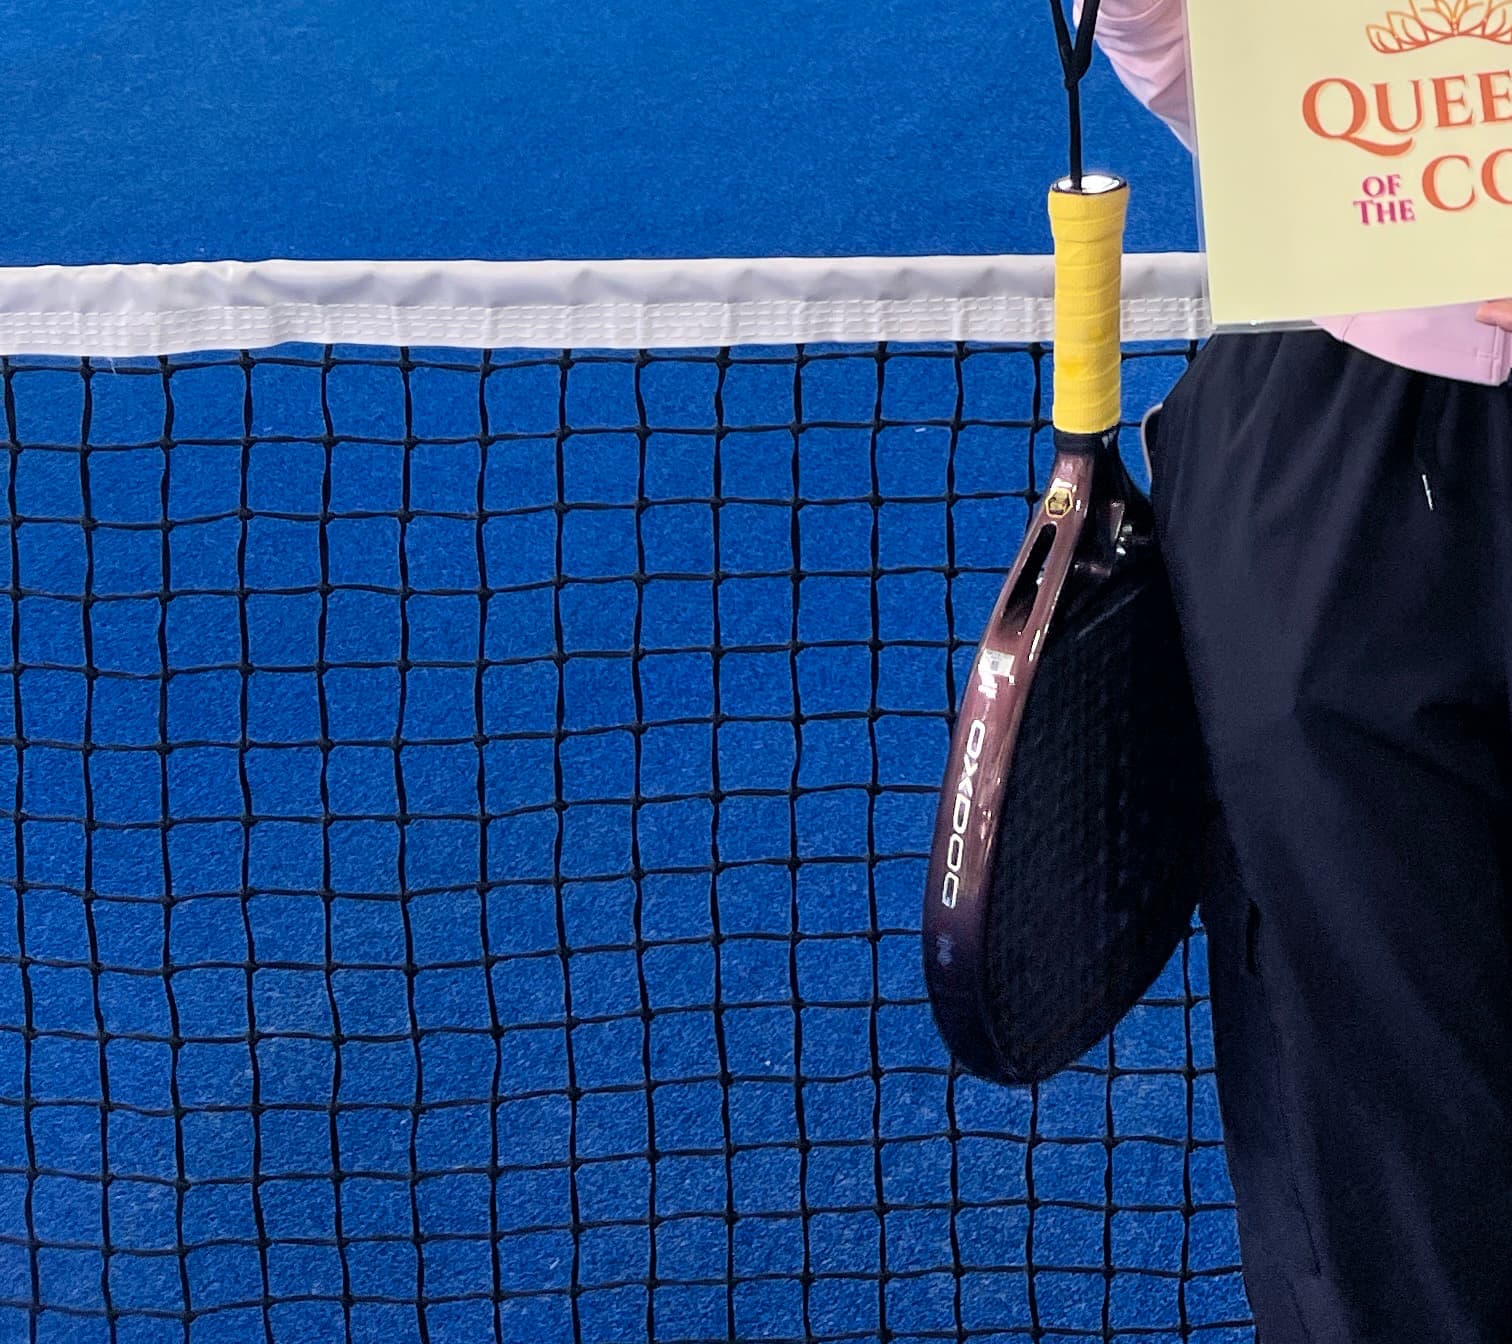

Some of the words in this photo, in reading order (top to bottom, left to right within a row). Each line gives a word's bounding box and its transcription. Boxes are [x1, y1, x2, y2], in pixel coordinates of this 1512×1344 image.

[1362, 173, 1401, 198] OF
[1353, 199, 1416, 226] THE
[942, 719, 985, 909] OXDOG
